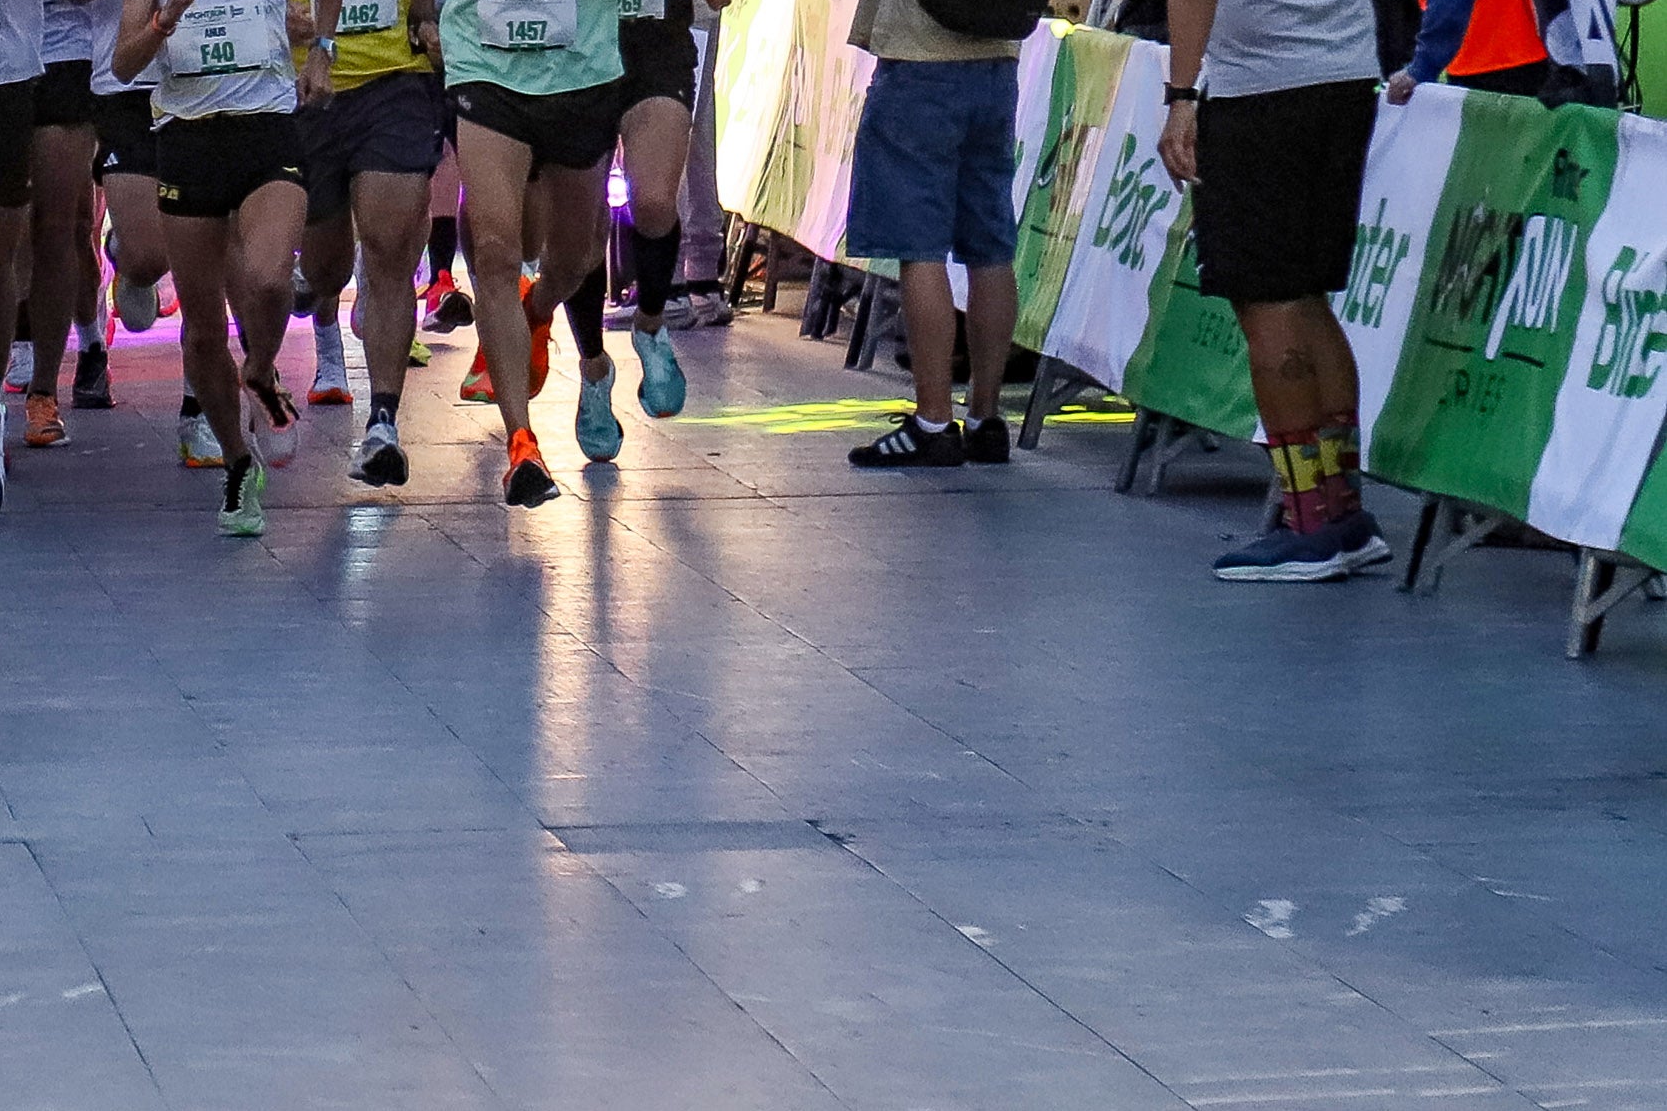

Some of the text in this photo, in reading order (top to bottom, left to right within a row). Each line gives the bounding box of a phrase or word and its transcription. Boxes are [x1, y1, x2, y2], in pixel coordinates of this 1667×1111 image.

[341, 3, 379, 25] 1462
[506, 21, 547, 41] 1457
[200, 42, 235, 65] F40
